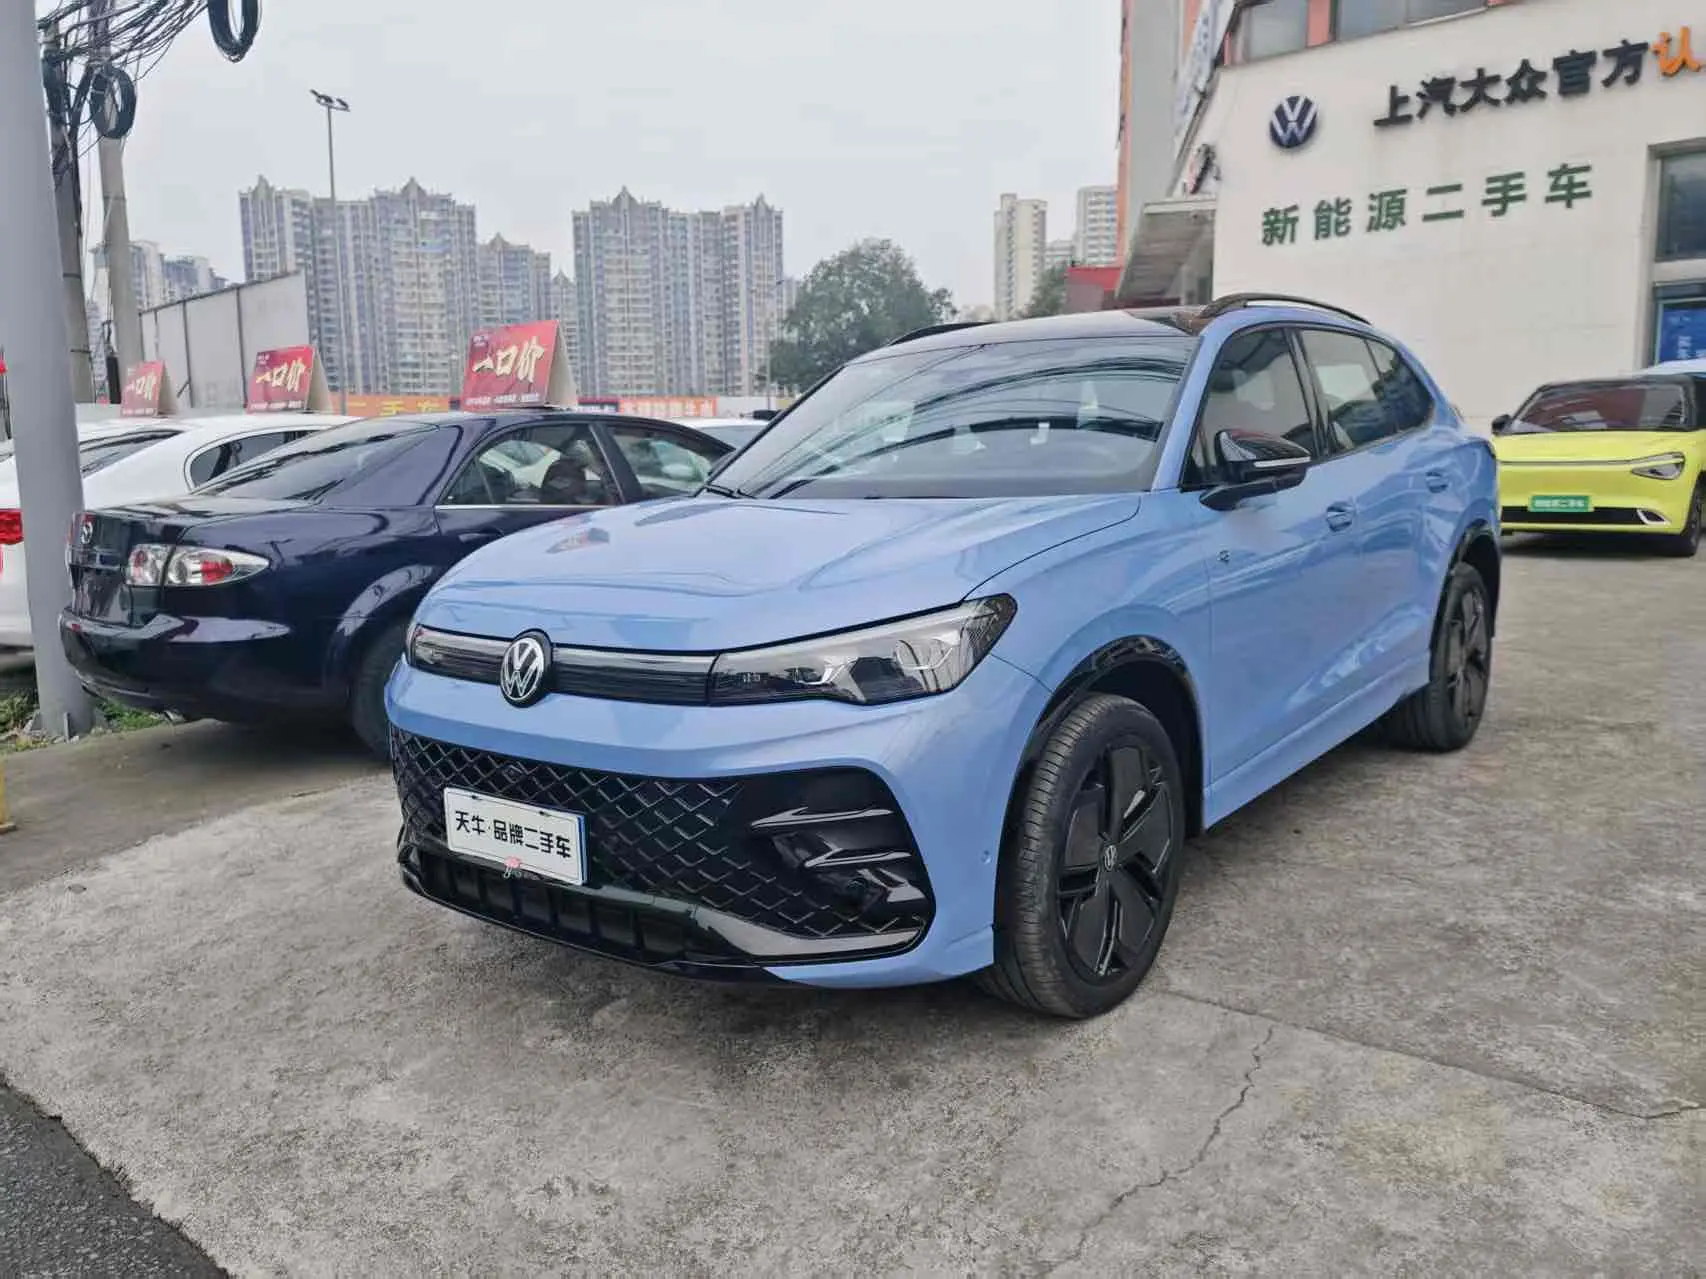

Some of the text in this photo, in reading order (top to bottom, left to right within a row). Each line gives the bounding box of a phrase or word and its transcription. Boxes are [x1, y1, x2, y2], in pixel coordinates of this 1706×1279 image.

[1373, 26, 1705, 127] 上汽大众官方认
[1261, 163, 1593, 246] 新能源二手车
[255, 357, 306, 393] 一口价
[472, 336, 545, 383] 一口价
